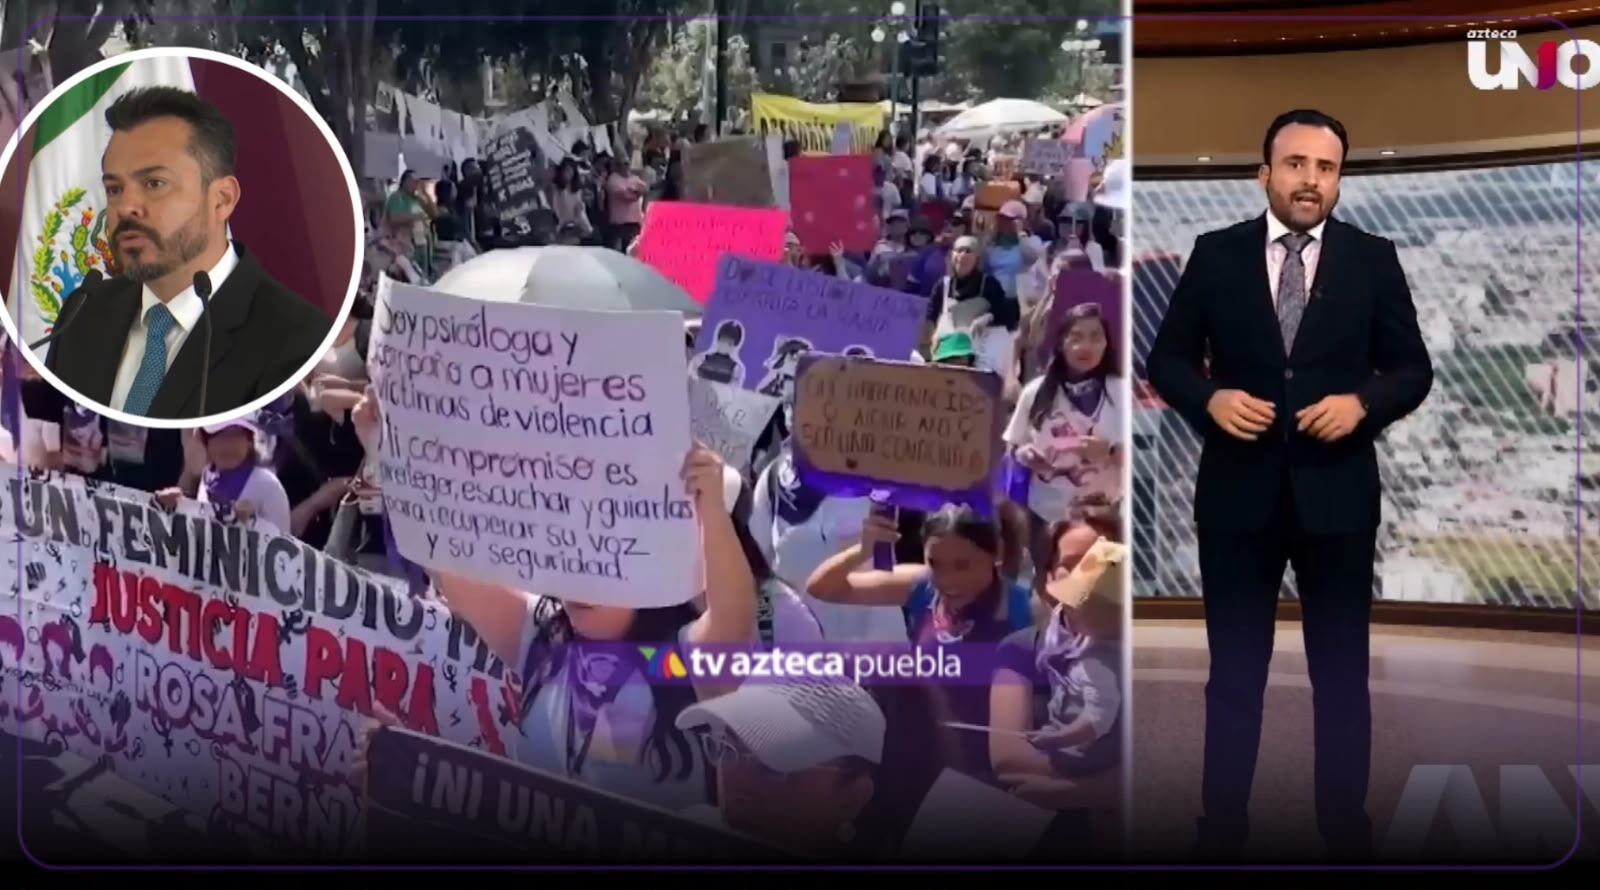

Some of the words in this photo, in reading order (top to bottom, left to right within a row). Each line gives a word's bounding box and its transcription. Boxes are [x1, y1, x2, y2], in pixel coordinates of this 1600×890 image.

[422, 304, 552, 363] psicóloga
[560, 331, 578, 365] y
[374, 342, 461, 386] compaño
[470, 364, 493, 391] a
[503, 367, 646, 403] mujeres
[480, 398, 510, 429] de
[514, 403, 653, 438] violencia
[409, 436, 594, 481] compromiso
[605, 460, 637, 487] es
[429, 506, 540, 541] recuperar
[549, 525, 576, 550] su
[588, 531, 651, 557] voz
[462, 479, 571, 515] escuchar
[583, 499, 595, 530] y
[598, 484, 694, 530] guiarlas
[9, 477, 81, 546] UN
[94, 494, 425, 640] FEMINICIDIO
[426, 531, 439, 560] y
[448, 537, 475, 558] su
[488, 543, 629, 582] seguridad.
[91, 562, 284, 688] JUSTICIA
[303, 626, 440, 737] PARA
[135, 647, 253, 750] ROSA
